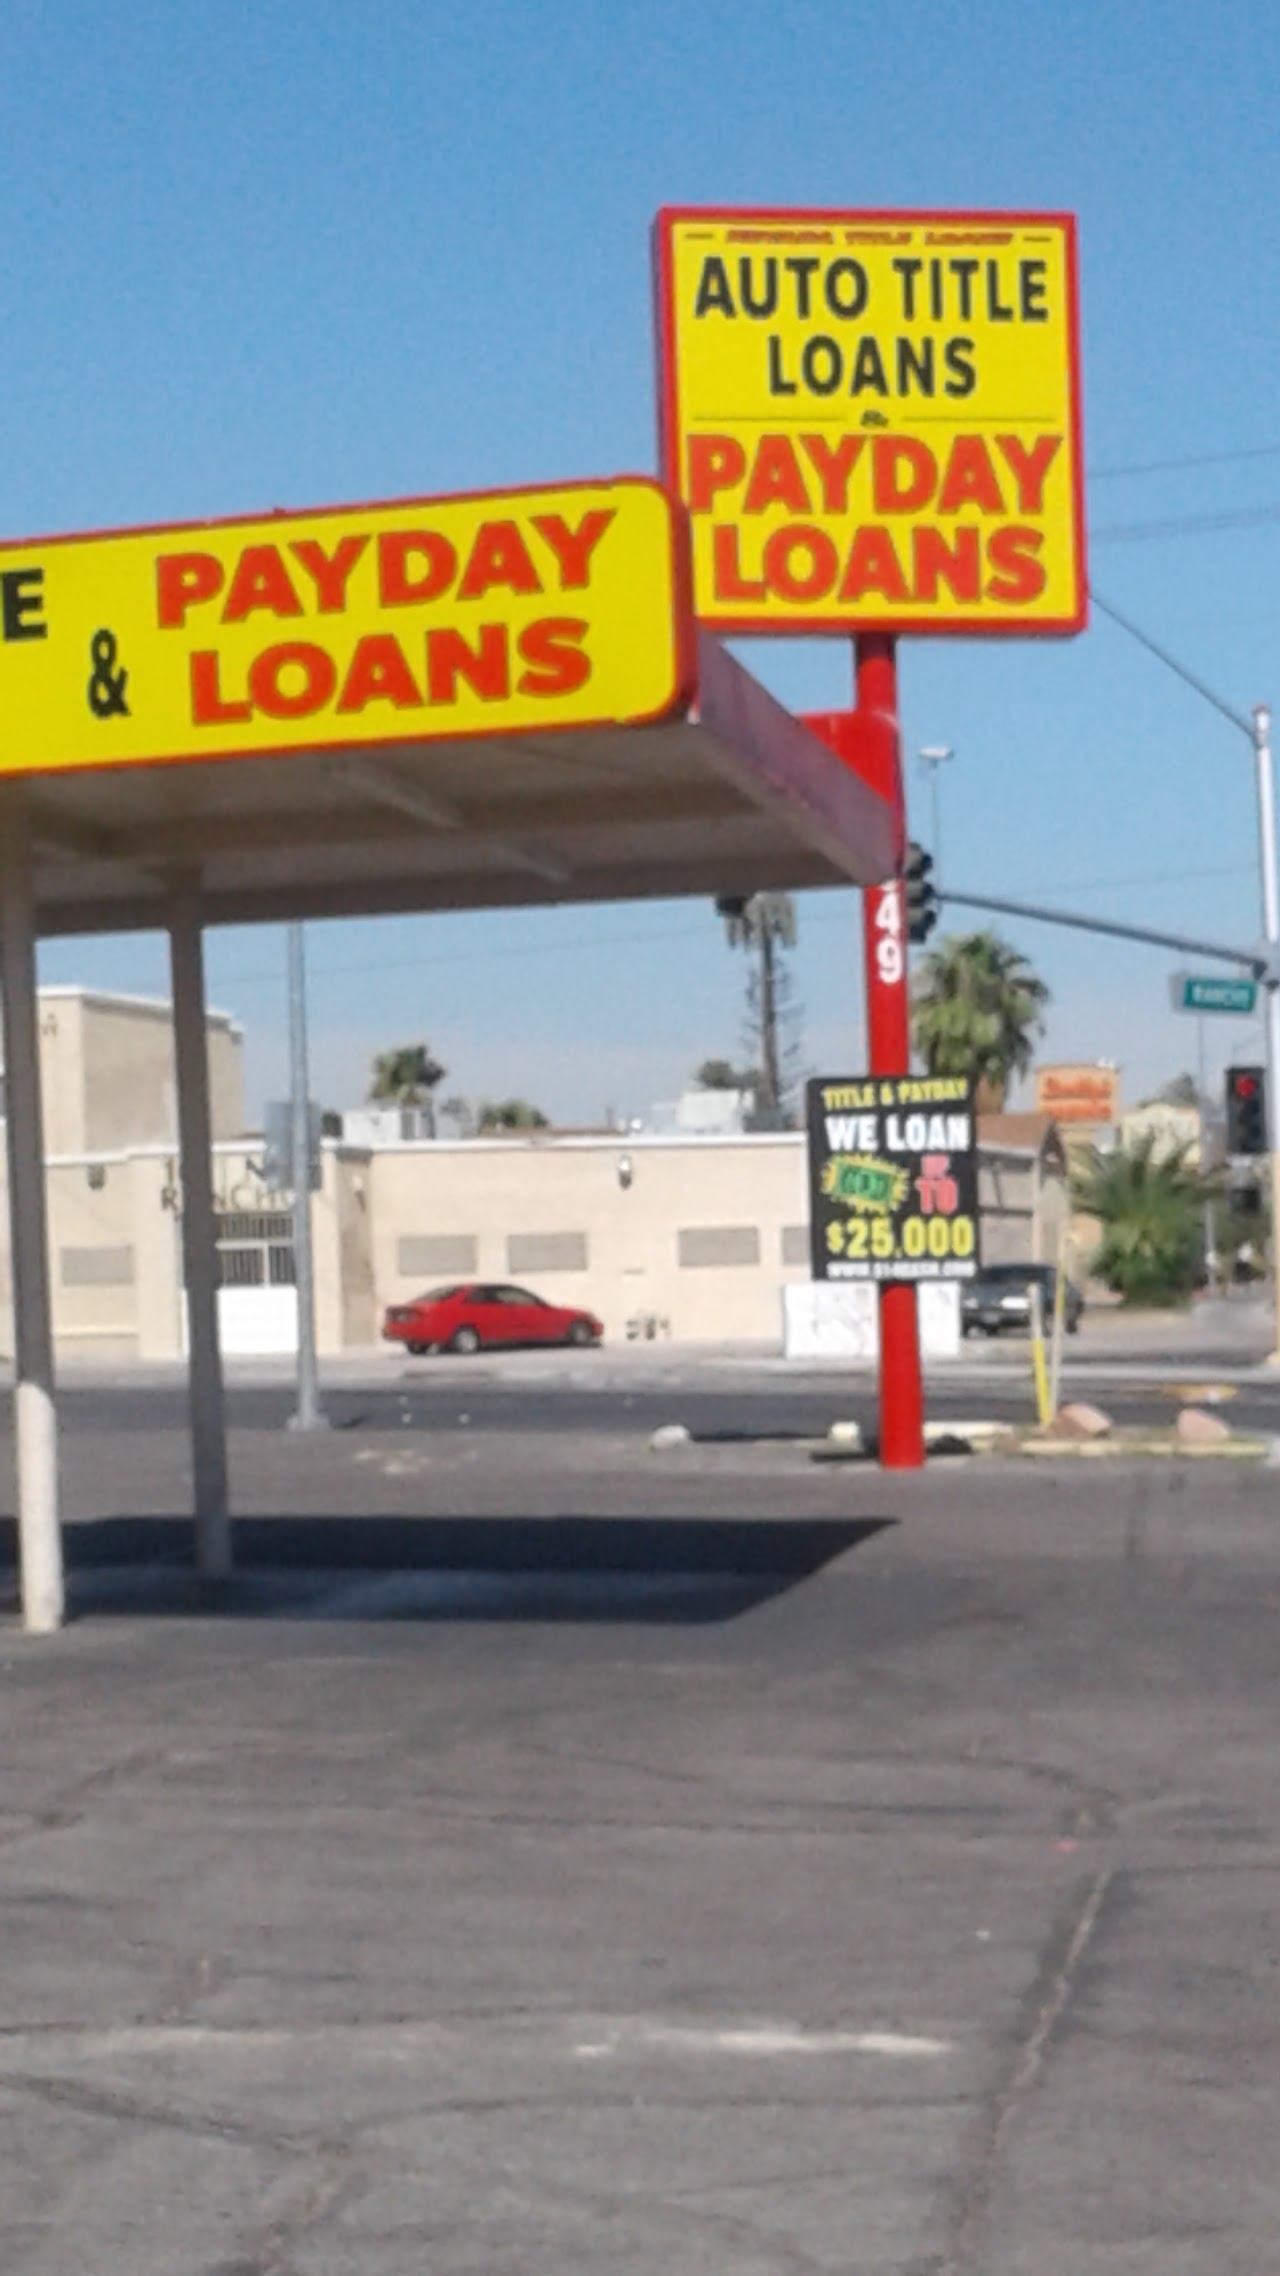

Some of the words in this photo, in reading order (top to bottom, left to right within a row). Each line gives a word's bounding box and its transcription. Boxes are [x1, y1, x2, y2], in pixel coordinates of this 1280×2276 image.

[695, 256, 869, 320] AUTO
[892, 258, 1049, 322] TITLE
[769, 335, 977, 398] LOANS
[687, 434, 1062, 515] PAYDAY
[155, 508, 617, 631] PAYDAY
[713, 524, 1047, 604] LOANS
[88, 628, 130, 720] &
[189, 616, 593, 727] LOANS
[822, 1083, 875, 1111] TITLE
[898, 1077, 968, 1105] PAYDAY
[824, 1113, 878, 1151] WE
[885, 1112, 970, 1151] LOAN
[914, 1175, 958, 1215] TO
